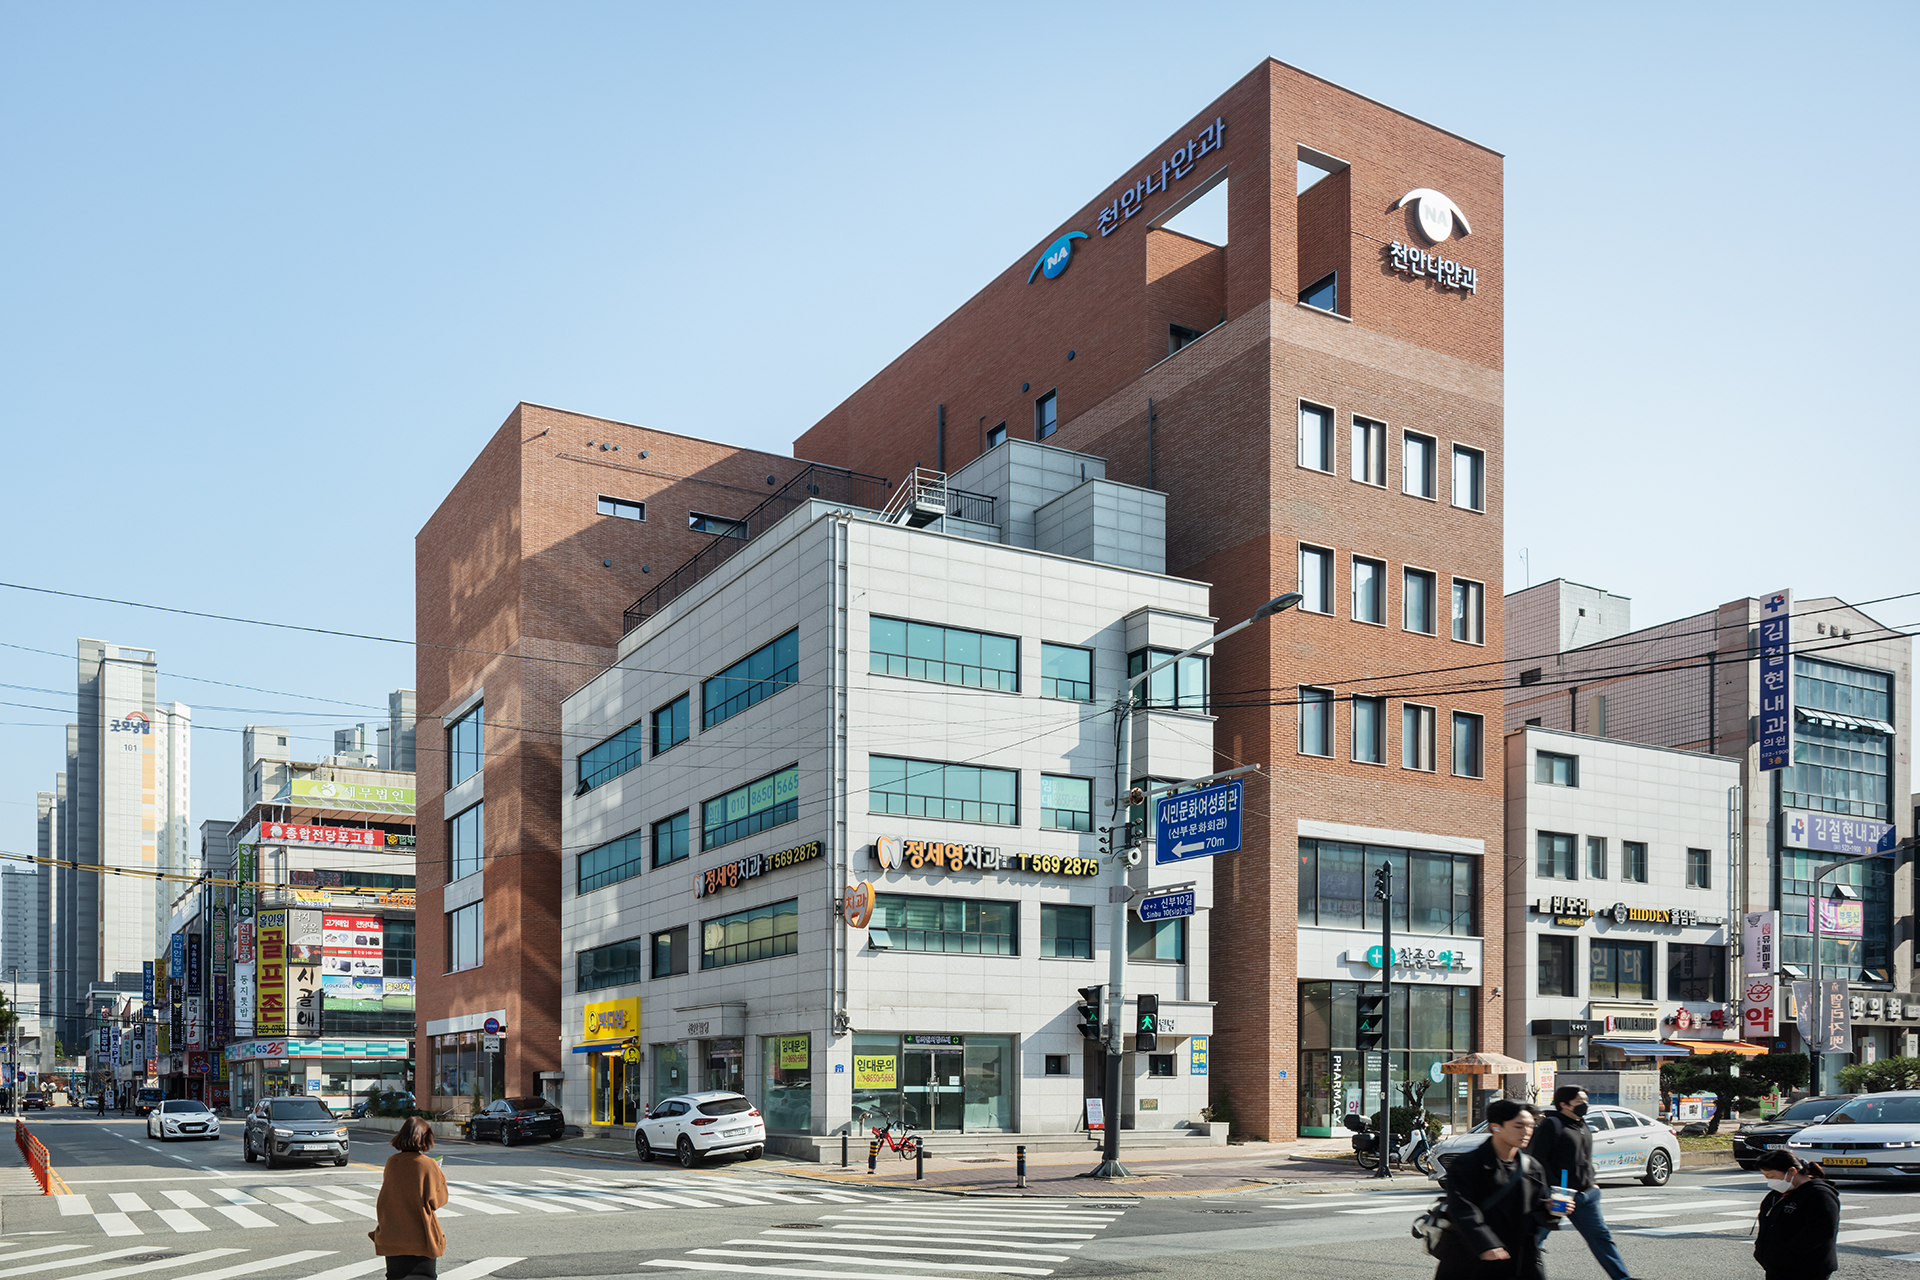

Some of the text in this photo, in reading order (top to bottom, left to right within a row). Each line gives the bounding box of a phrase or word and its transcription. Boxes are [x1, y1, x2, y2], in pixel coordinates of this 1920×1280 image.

[1097, 116, 1226, 237] 천안나안과
[1424, 203, 1449, 228] NA
[1047, 247, 1069, 270] NA
[1390, 240, 1479, 295] 천안나안과
[1763, 620, 1788, 735] 김철현내과
[110, 719, 150, 735] 굿모닝힐
[124, 744, 137, 752] 101
[1763, 735, 1786, 748] 의원
[342, 786, 405, 802] 세무법인
[731, 796, 746, 813] 010
[751, 785, 773, 806] 8650
[777, 774, 799, 795] 5665
[1054, 781, 1064, 791] 010
[1160, 788, 1239, 825] 시민문화여성회관
[285, 826, 375, 845] 종합전당포그룹
[1168, 817, 1228, 840] (신부문화회관)
[1814, 818, 1881, 845] 김철현내과
[1205, 836, 1225, 848] 70m
[905, 840, 1098, 876] 정세영치과 T 569 2875
[705, 854, 762, 894] 정세영치과
[379, 894, 416, 908] 마임화
[845, 893, 867, 910] 치과
[1161, 894, 1192, 909] 신부10길
[259, 913, 285, 929] 홀인원
[1628, 908, 1670, 923] HIDDEN
[240, 924, 250, 954] 전당포
[1399, 947, 1466, 971] 참좋은약국
[259, 930, 285, 1022] 골프존
[1745, 1007, 1773, 1032] 약
[256, 1041, 285, 1056] GS25
[781, 1040, 807, 1053] 임대문의
[1192, 1039, 1206, 1051] 임대
[857, 1058, 895, 1073] 임대문의
[1192, 1053, 1206, 1064] 문의
[1333, 1055, 1342, 1124] PHARMACY
